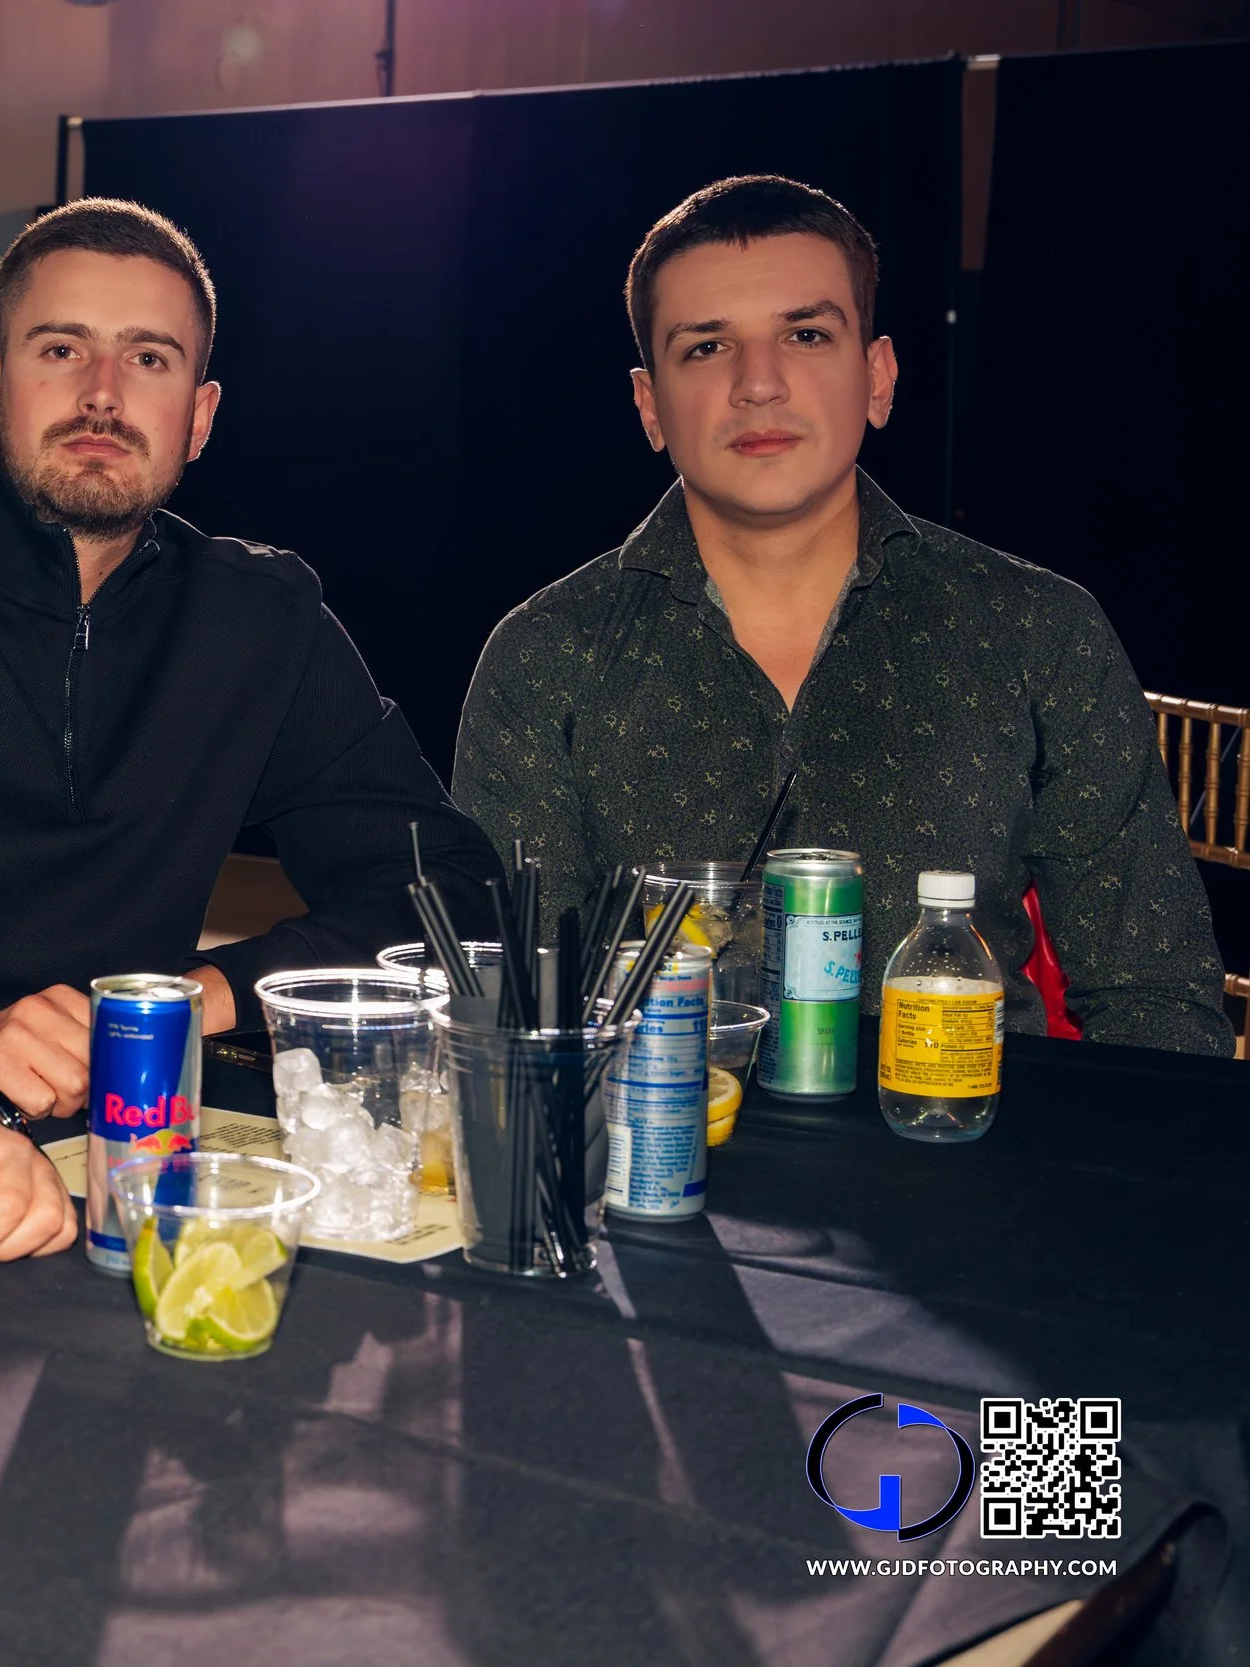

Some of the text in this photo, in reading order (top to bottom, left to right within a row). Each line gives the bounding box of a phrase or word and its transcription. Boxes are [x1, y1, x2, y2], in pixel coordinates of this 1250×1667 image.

[898, 1002, 930, 1012] Nutrition
[898, 1010, 917, 1020] Facts
[898, 1023, 915, 1031] Serving
[898, 1037, 917, 1045] Calories
[106, 1092, 196, 1128] Red Bu
